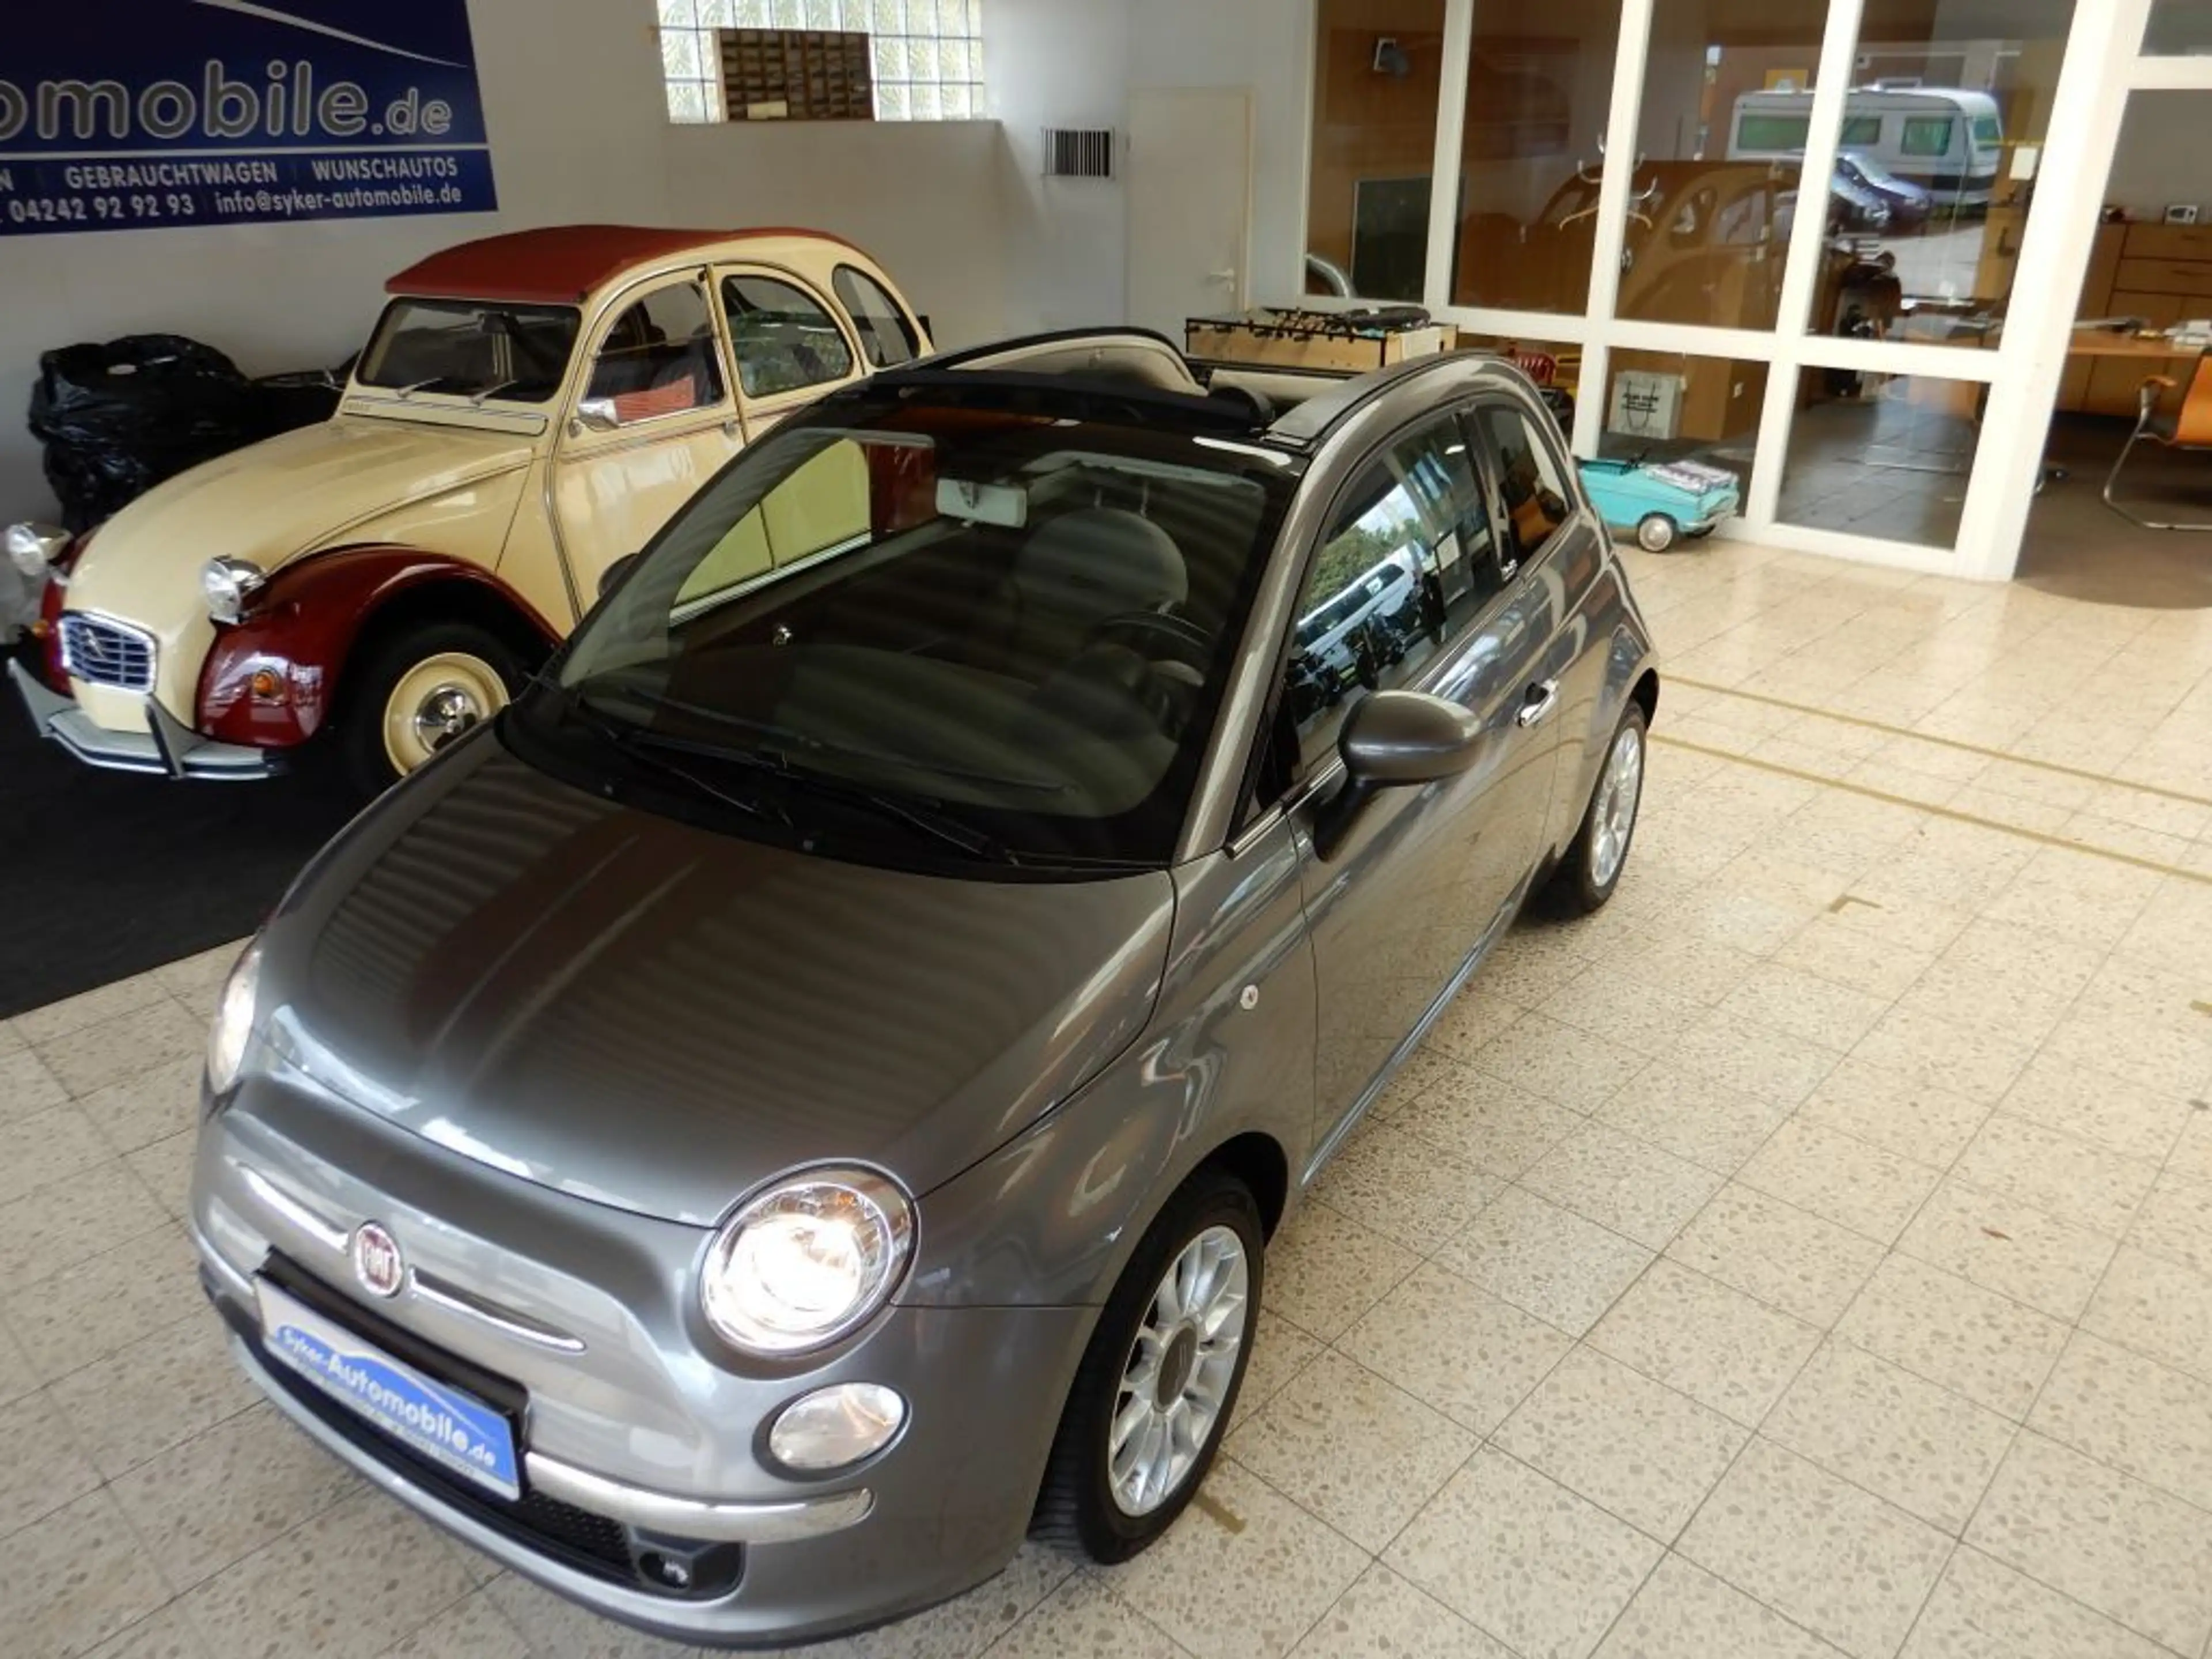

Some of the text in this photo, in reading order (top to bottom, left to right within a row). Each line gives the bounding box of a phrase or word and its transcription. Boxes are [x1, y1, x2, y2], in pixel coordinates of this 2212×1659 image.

[65, 157, 458, 189] GEBRAUCHTWAGEN WUNSCHAUTOS
[8, 183, 462, 223] 04242 92 92 93 info@syker-automobile.de
